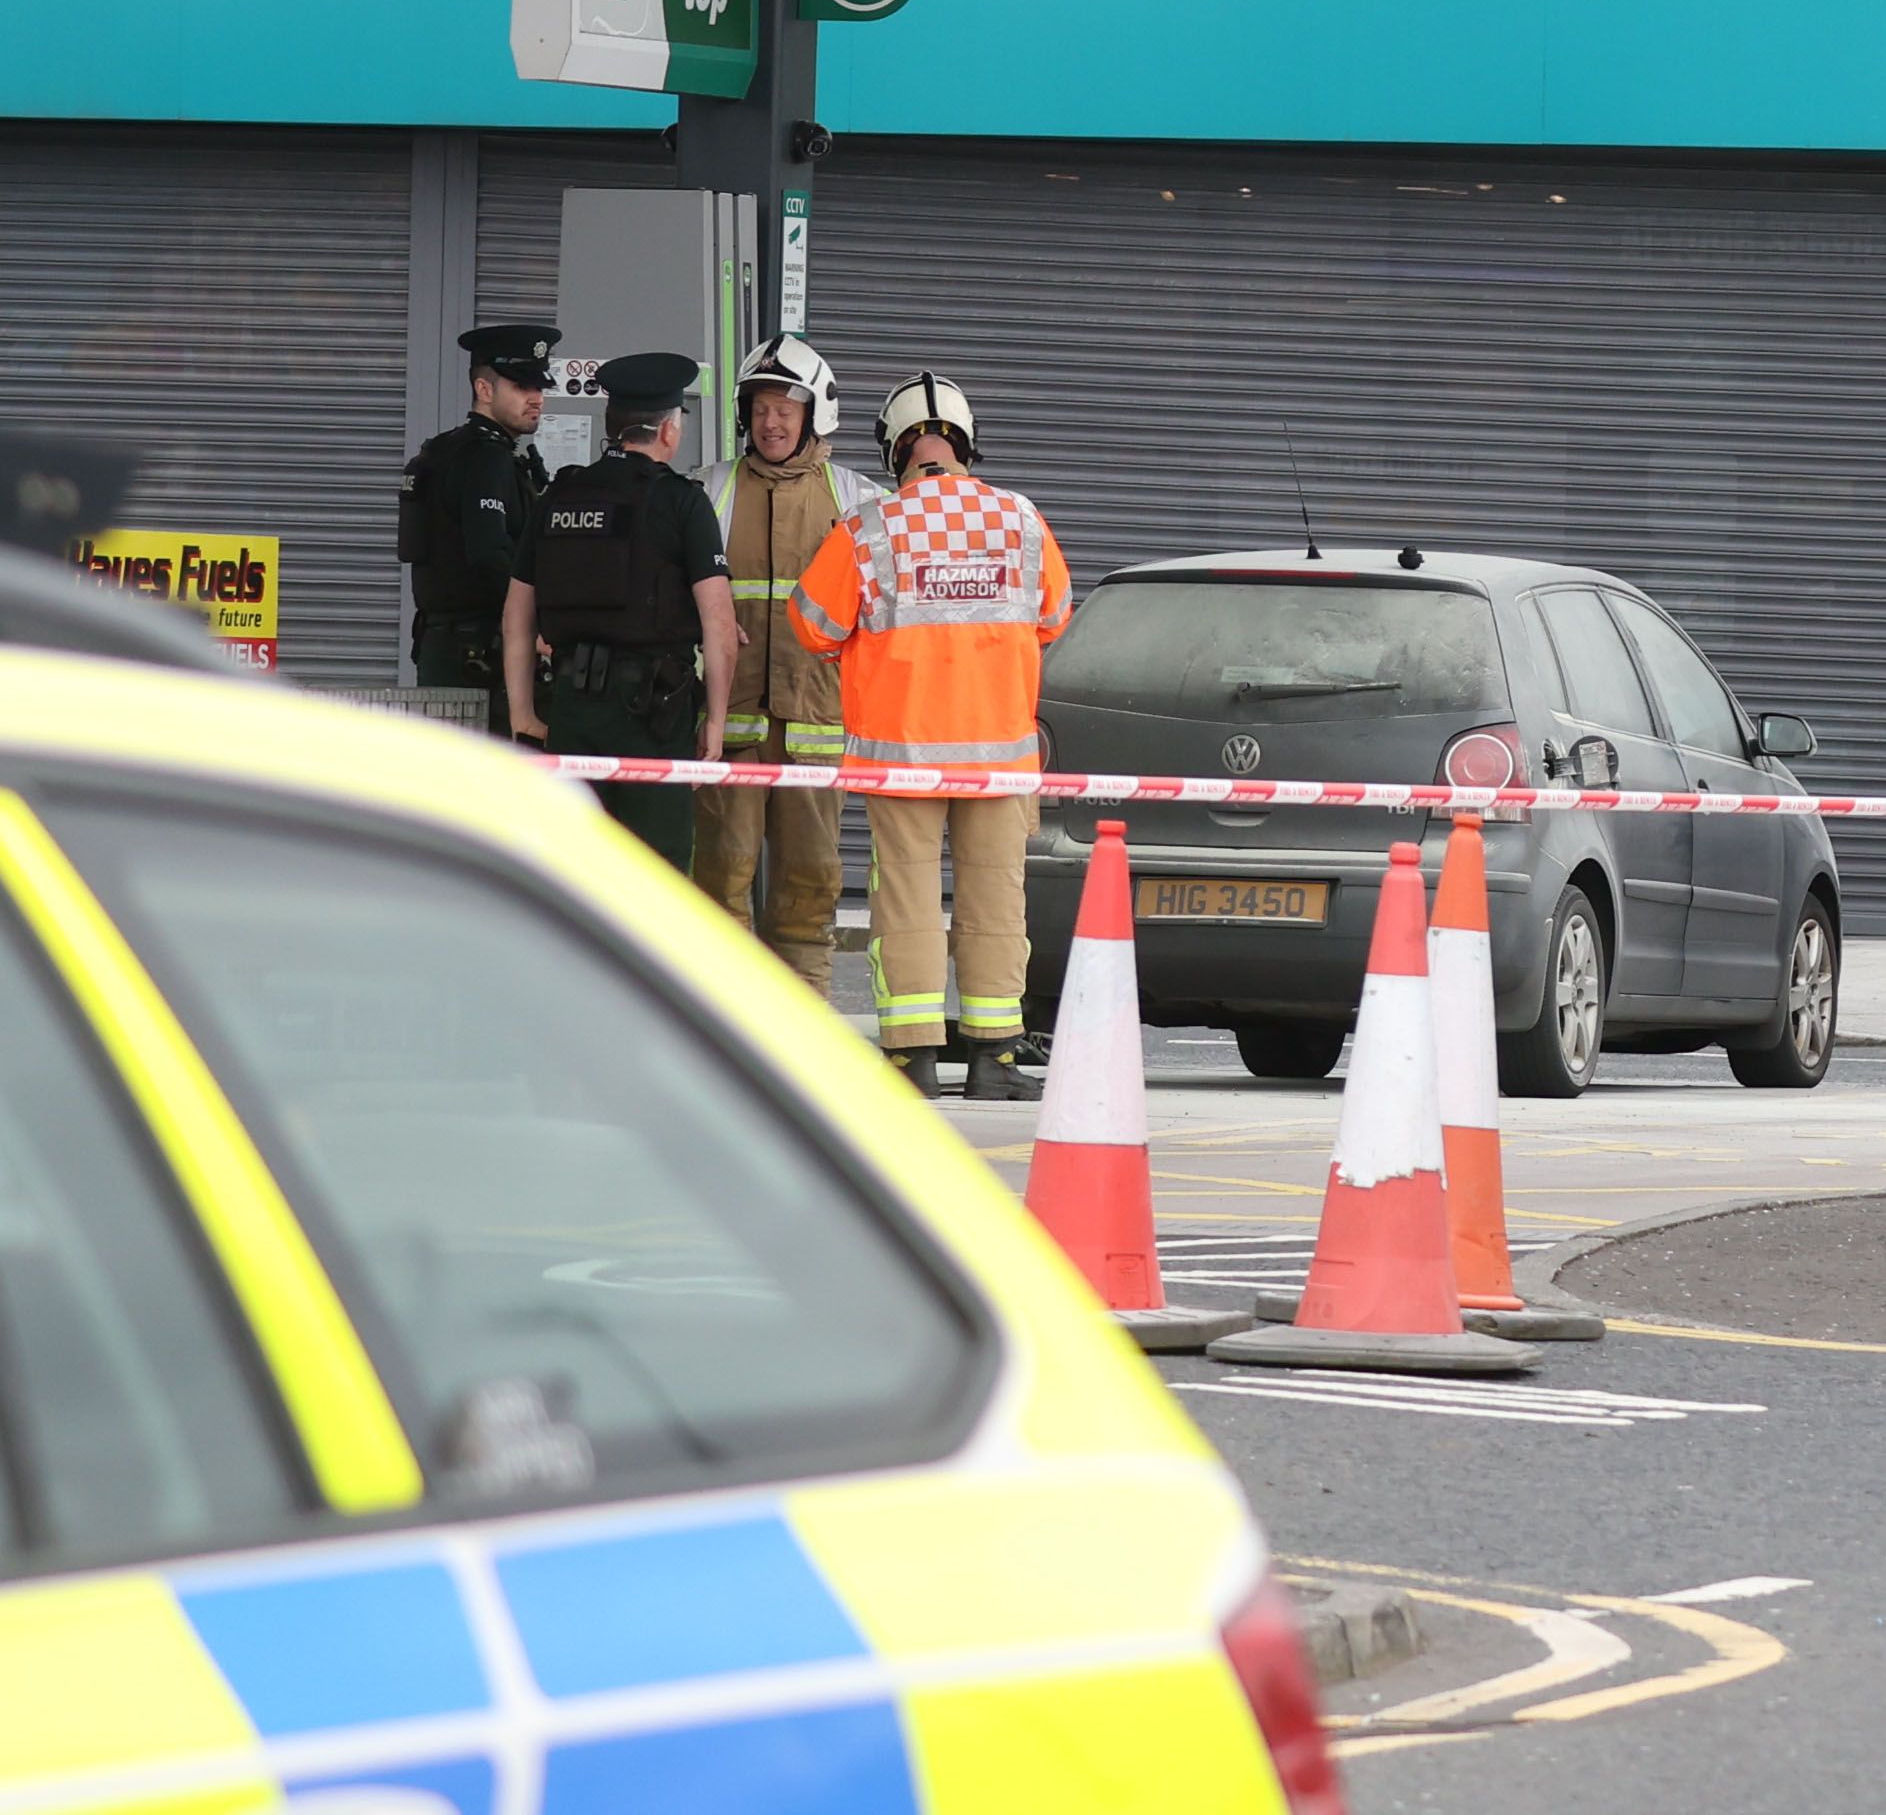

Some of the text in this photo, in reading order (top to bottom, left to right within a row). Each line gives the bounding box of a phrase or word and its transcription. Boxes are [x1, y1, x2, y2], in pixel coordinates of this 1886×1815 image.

[786, 197, 805, 214] CCTV
[551, 510, 604, 529] POLICE
[177, 545, 267, 603] Fuels
[924, 568, 998, 582] HAZMAT
[923, 583, 1000, 597] ADVISOR
[218, 608, 262, 627] future
[1156, 884, 1306, 918] HIG 3450
